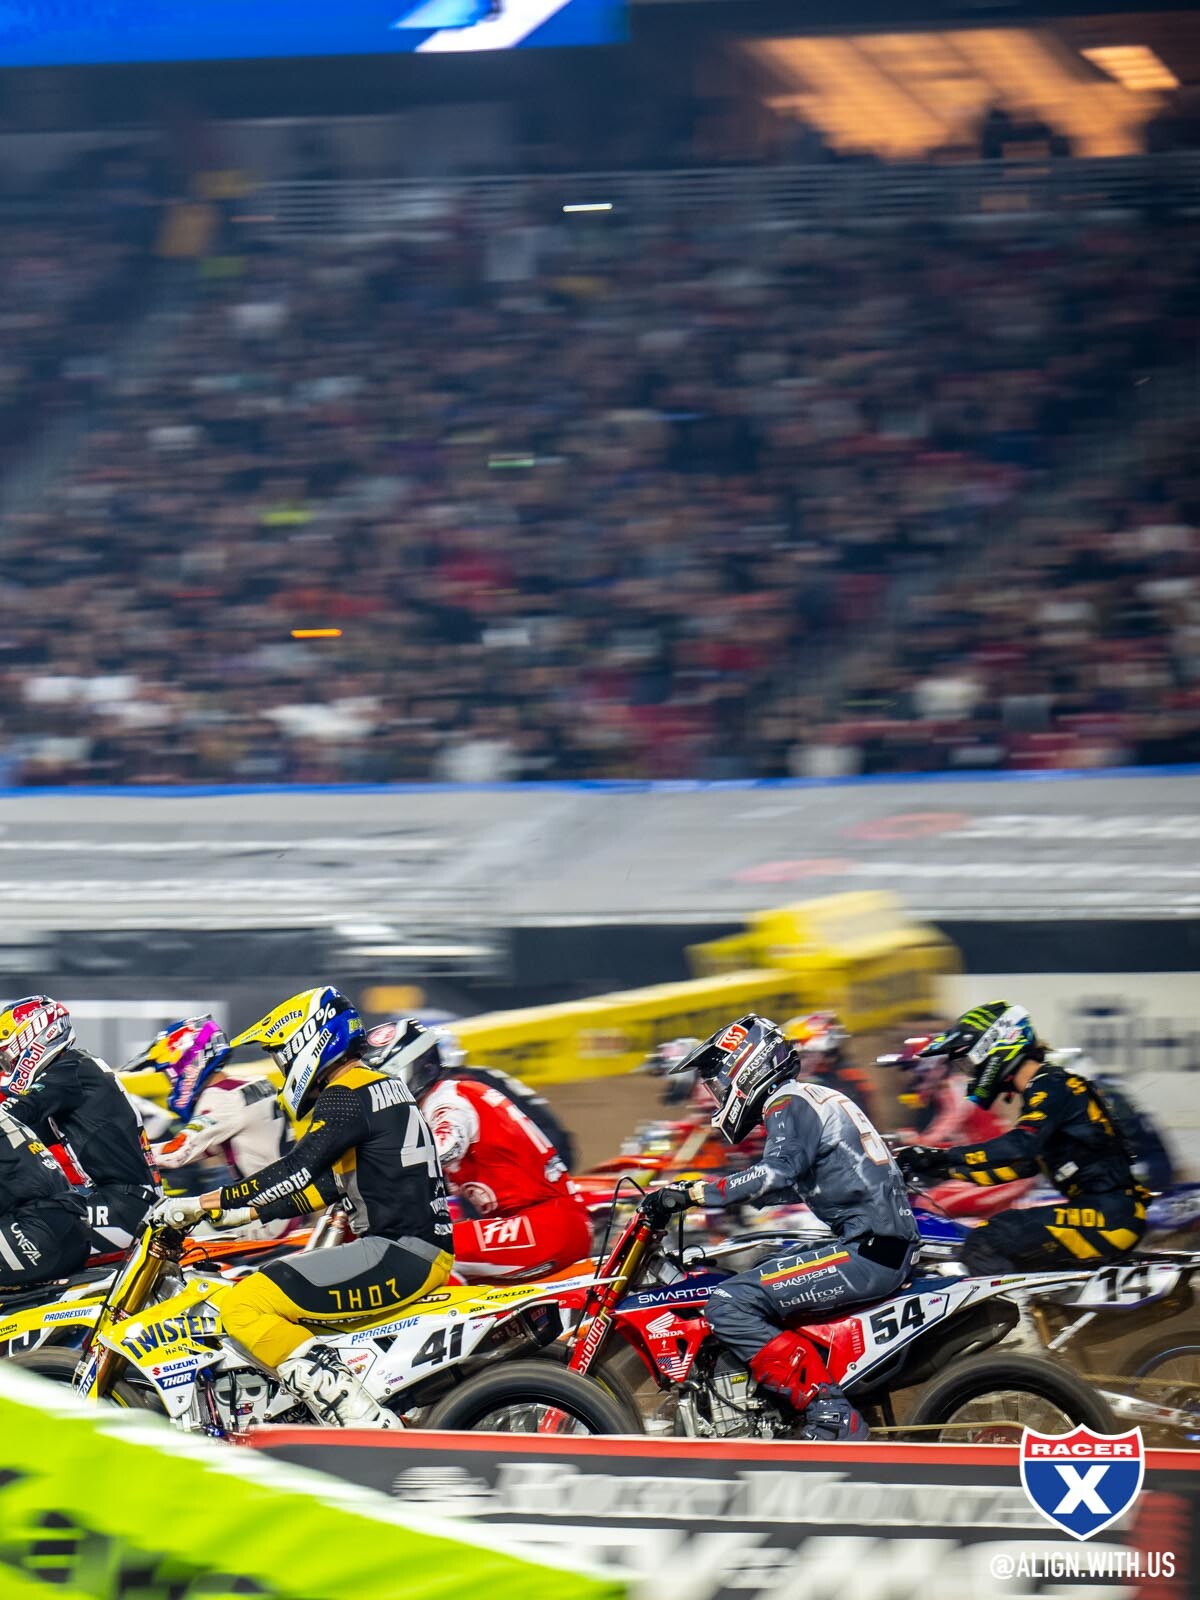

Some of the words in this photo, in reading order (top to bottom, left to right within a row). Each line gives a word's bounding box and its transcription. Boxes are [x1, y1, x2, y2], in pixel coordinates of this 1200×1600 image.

[265, 1014, 290, 1039] TWISTED
[289, 1009, 303, 1020] TEA
[278, 1003, 337, 1063] 100%
[311, 1029, 331, 1059] THOR
[246, 1180, 296, 1208] TWISTED
[289, 1167, 312, 1190] TEA
[328, 1277, 401, 1310] THOR
[486, 1288, 535, 1300] DUNLOP
[1098, 1257, 1151, 1301] 14
[44, 1308, 93, 1321] PROGRESSIVE
[869, 1296, 925, 1345] 54
[120, 1315, 216, 1360] TWISTED
[411, 1322, 465, 1368] 41
[648, 1330, 685, 1340] HONDA
[162, 1358, 199, 1373] SUZUKI
[162, 1372, 192, 1387] THOR
